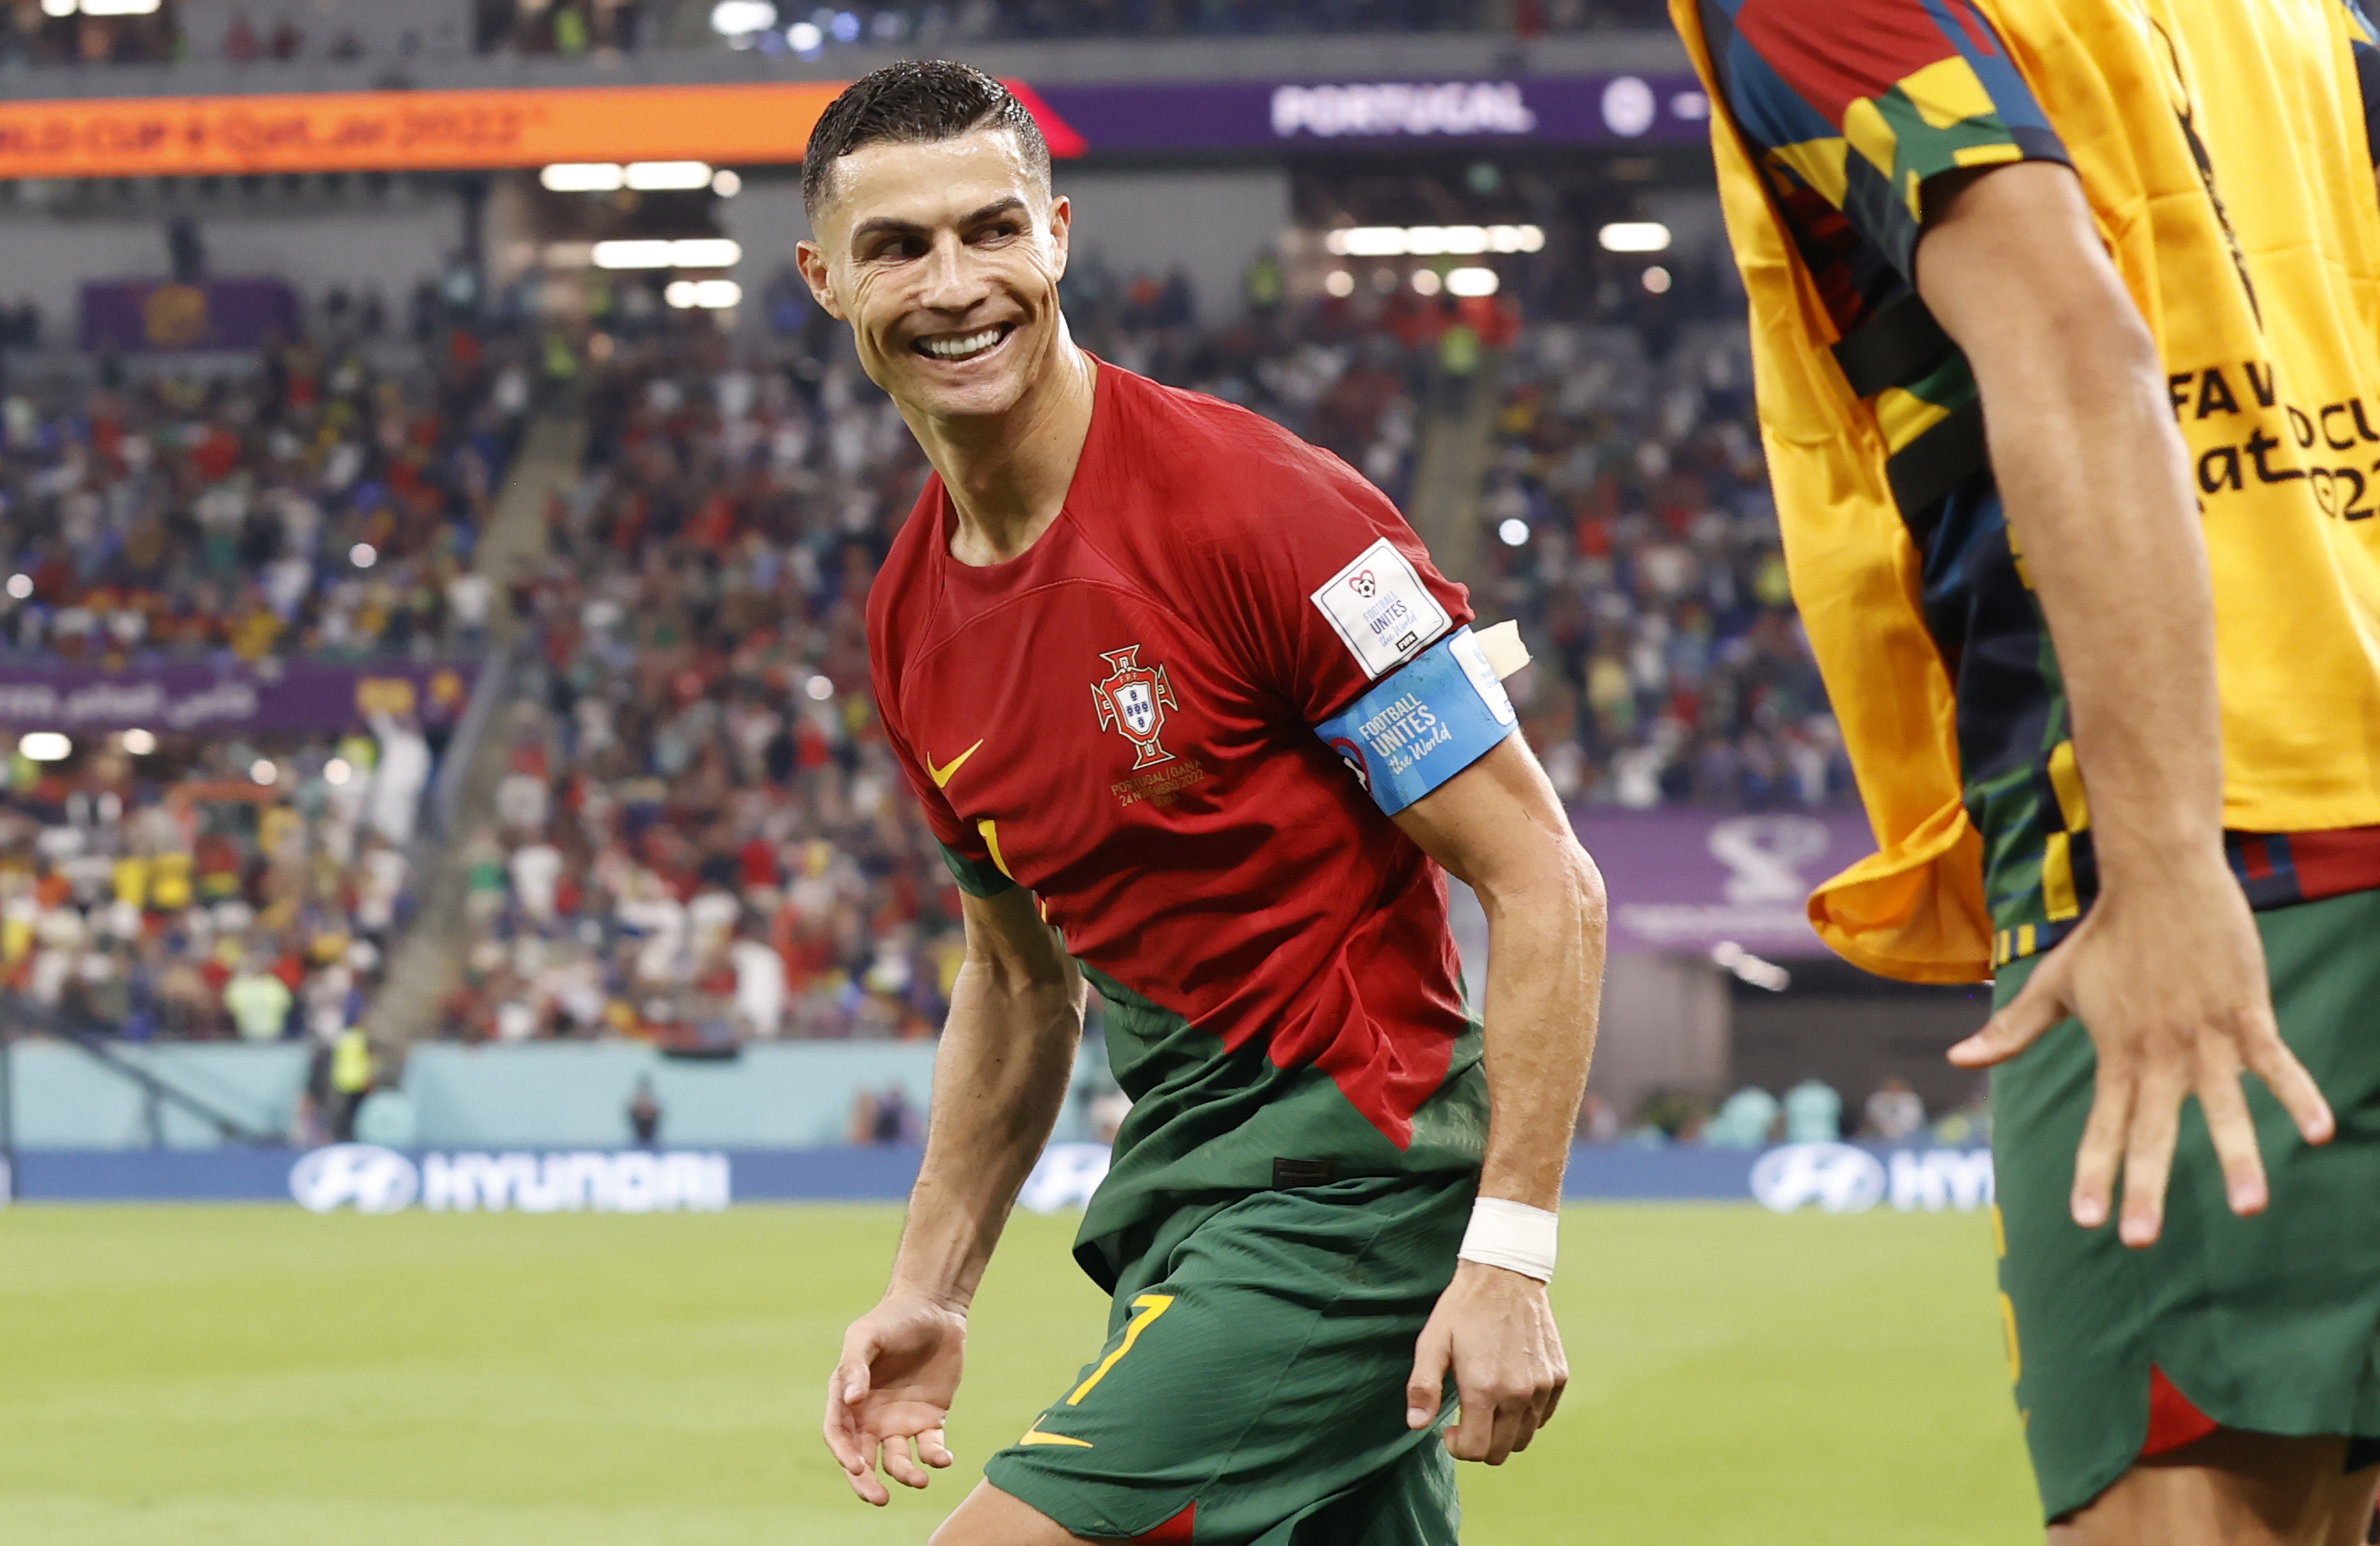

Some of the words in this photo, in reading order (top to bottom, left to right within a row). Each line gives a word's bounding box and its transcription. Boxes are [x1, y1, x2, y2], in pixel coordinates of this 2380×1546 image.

[1271, 84, 1536, 137] PORTUGAL
[1363, 591, 1398, 622] FOOTBALL
[1369, 600, 1407, 634] UNITES
[1378, 633, 1395, 647] the
[1391, 610, 1418, 636] World
[1398, 634, 1416, 650] FIFA
[1358, 693, 1423, 741] FOOTBALL
[1370, 705, 1437, 758] UNITES
[1388, 755, 1413, 775] the
[1408, 722, 1452, 760] World
[1119, 794, 1133, 807] 24
[422, 1150, 732, 1214] HYUNDAI
[1066, 1294, 1175, 1407] 7
